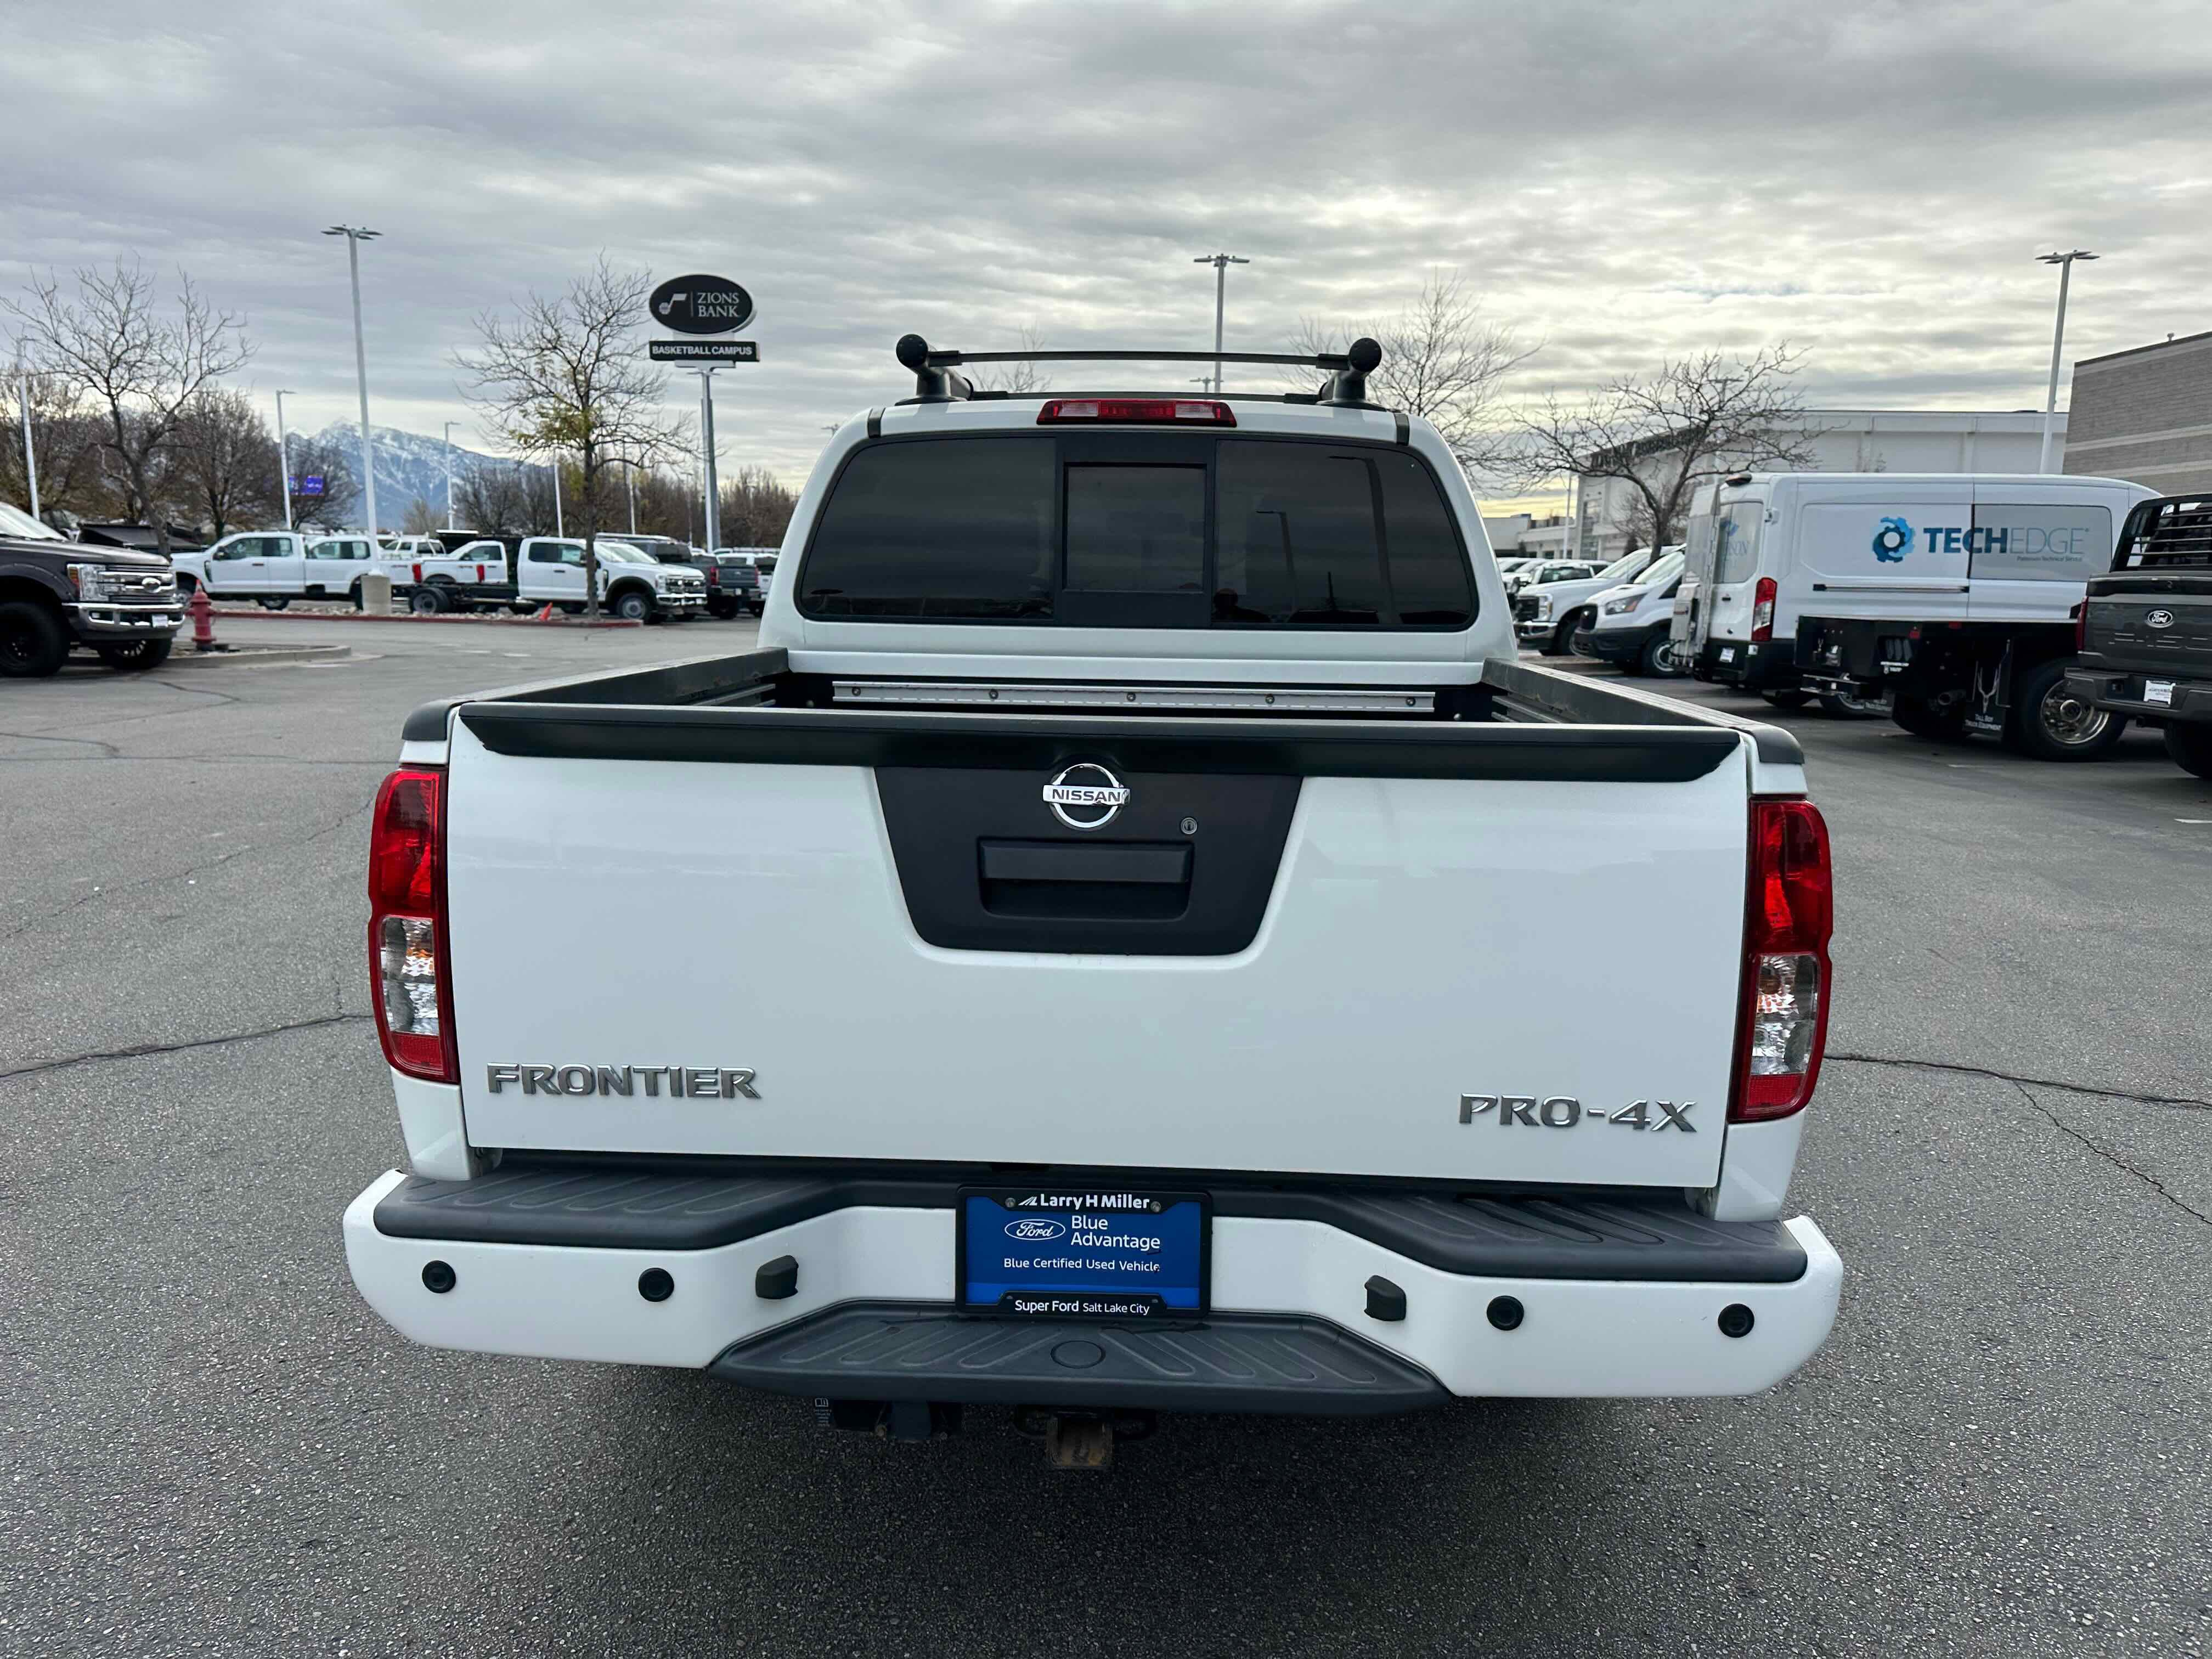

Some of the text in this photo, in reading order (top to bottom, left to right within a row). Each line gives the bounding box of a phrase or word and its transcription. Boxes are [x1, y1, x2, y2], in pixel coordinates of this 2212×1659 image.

[698, 292, 740, 303] ZIONS
[698, 305, 738, 317] BANK
[652, 346, 752, 355] BASKETBALL CAMPUS
[2152, 612, 2169, 623] Ford
[1052, 788, 1121, 803] NISSAN
[487, 1062, 761, 1099] FRONTIER
[1459, 1092, 1697, 1132] PRO-4X
[1040, 1193, 1149, 1210] Larry H Miller
[1016, 1221, 1054, 1238] Ford
[1071, 1215, 1108, 1230] Blue
[1070, 1231, 1161, 1251] Advantage
[1004, 1257, 1160, 1272] Blue Certified Used Vehicle
[1014, 1300, 1150, 1316] Super Ford Salt Lake City
